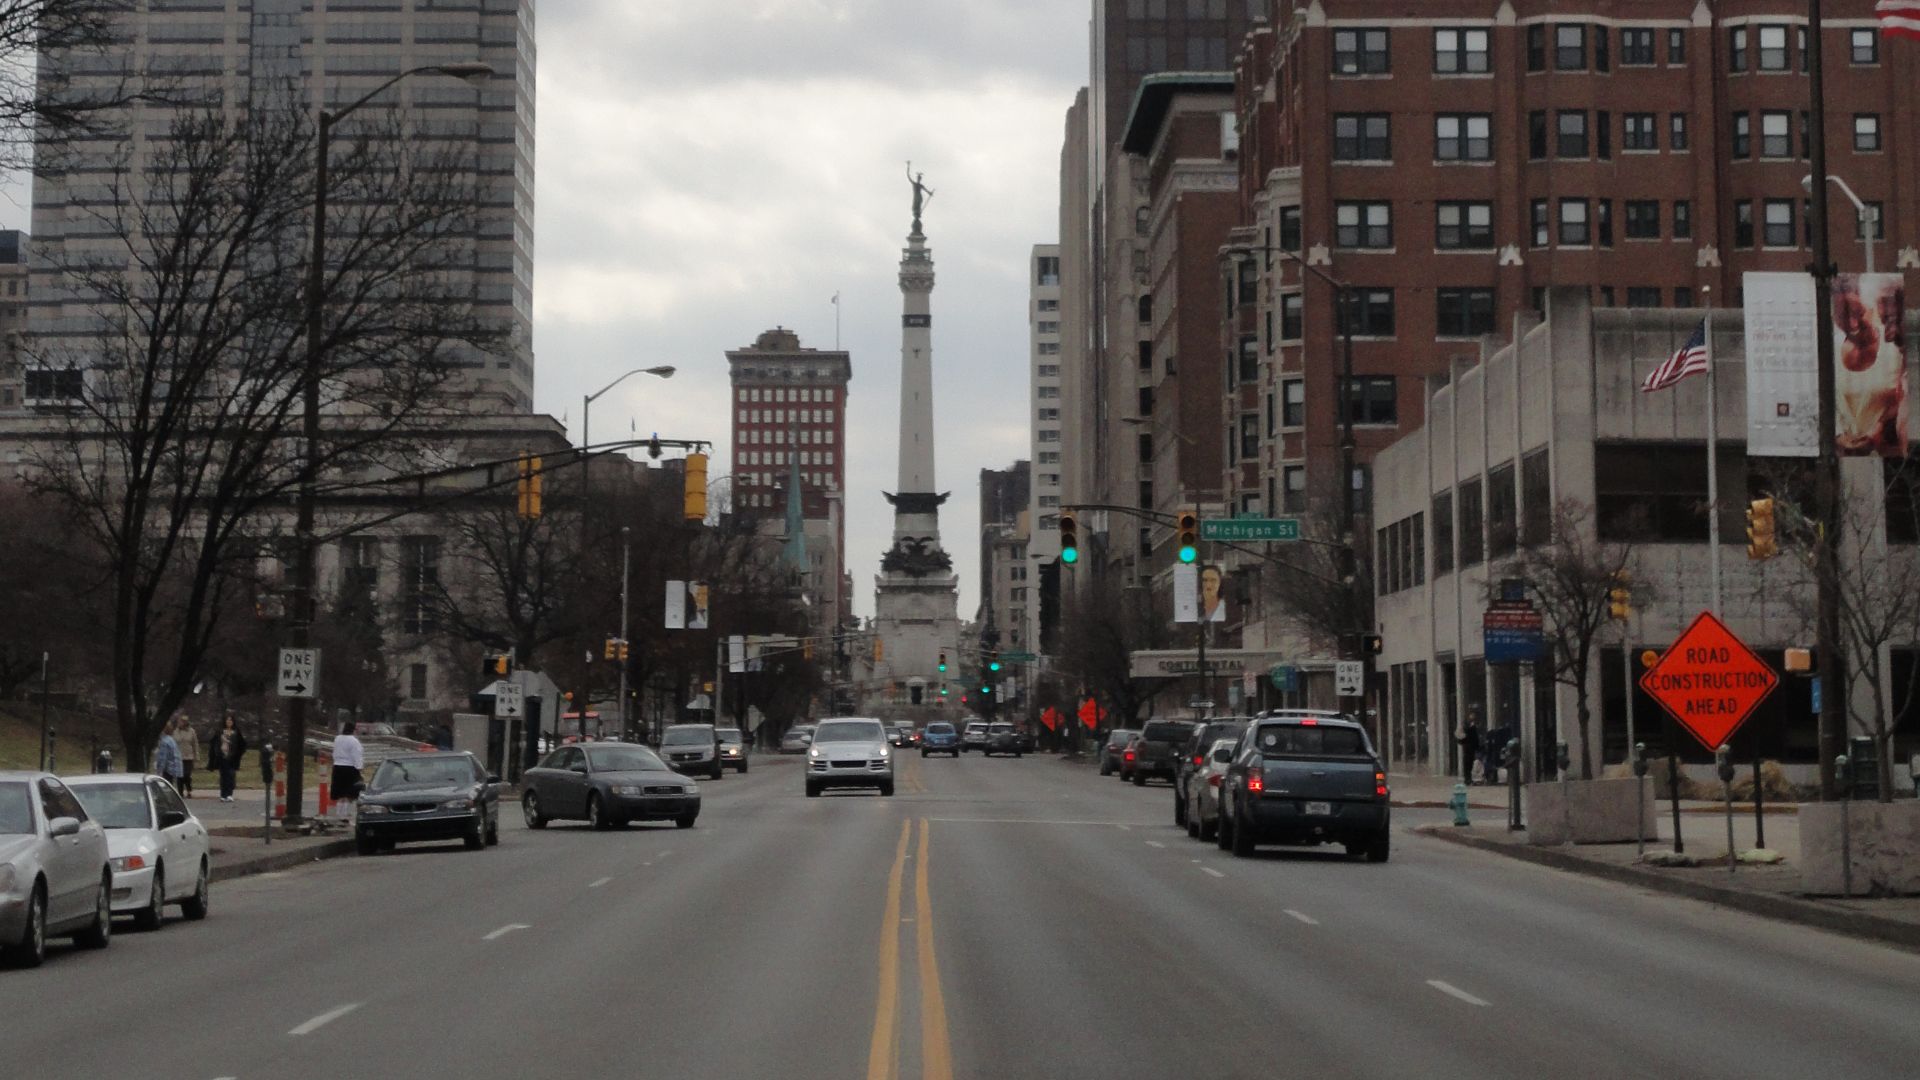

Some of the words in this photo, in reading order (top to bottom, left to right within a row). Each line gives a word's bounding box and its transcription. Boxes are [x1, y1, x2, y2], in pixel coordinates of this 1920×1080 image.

[1206, 524, 1271, 538] Michigan
[1279, 524, 1294, 535] St
[284, 653, 311, 664] ONE
[1686, 647, 1730, 665] ROAD
[1158, 660, 1244, 671] CONTINNTAL
[1340, 664, 1360, 673] ONE
[282, 670, 312, 680] WAY
[1339, 676, 1361, 684] WAY
[1650, 671, 1768, 691] CONSTRUCTION
[500, 686, 520, 694] ONE
[499, 697, 520, 705] WAY
[1685, 697, 1738, 715] AHEAD
